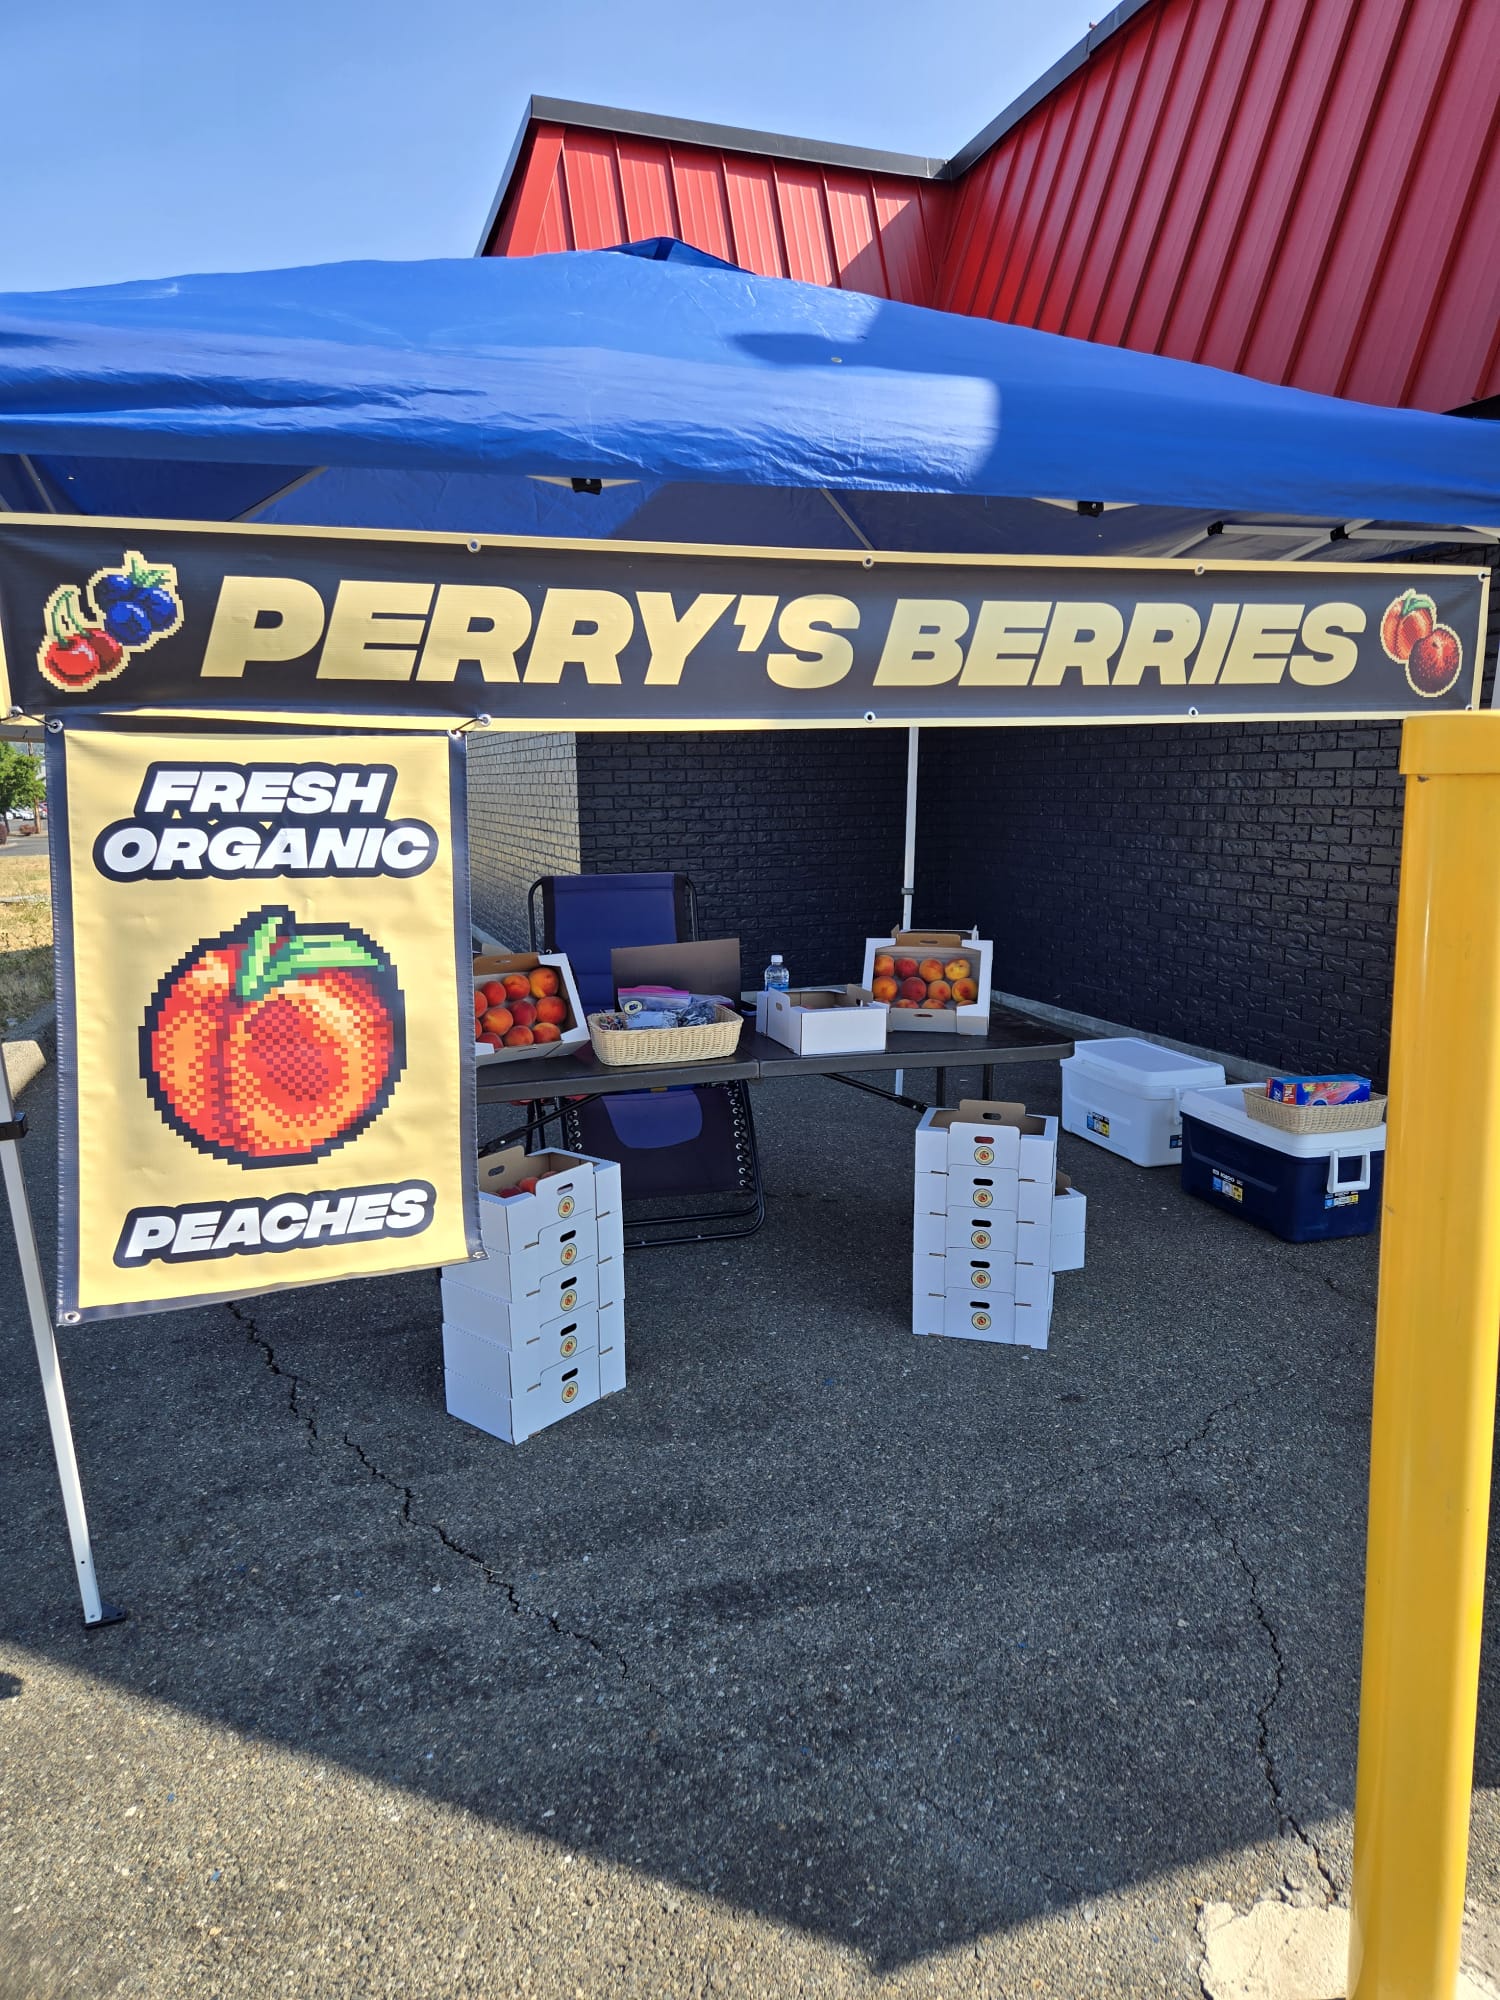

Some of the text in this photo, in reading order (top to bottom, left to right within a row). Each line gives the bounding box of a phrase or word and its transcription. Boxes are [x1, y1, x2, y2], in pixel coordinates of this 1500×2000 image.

[200, 575, 1368, 689] PERRY'S BERRIES
[144, 770, 387, 813] FRESH
[103, 826, 431, 873] ORGANIC
[124, 1188, 429, 1259] PEACHES
